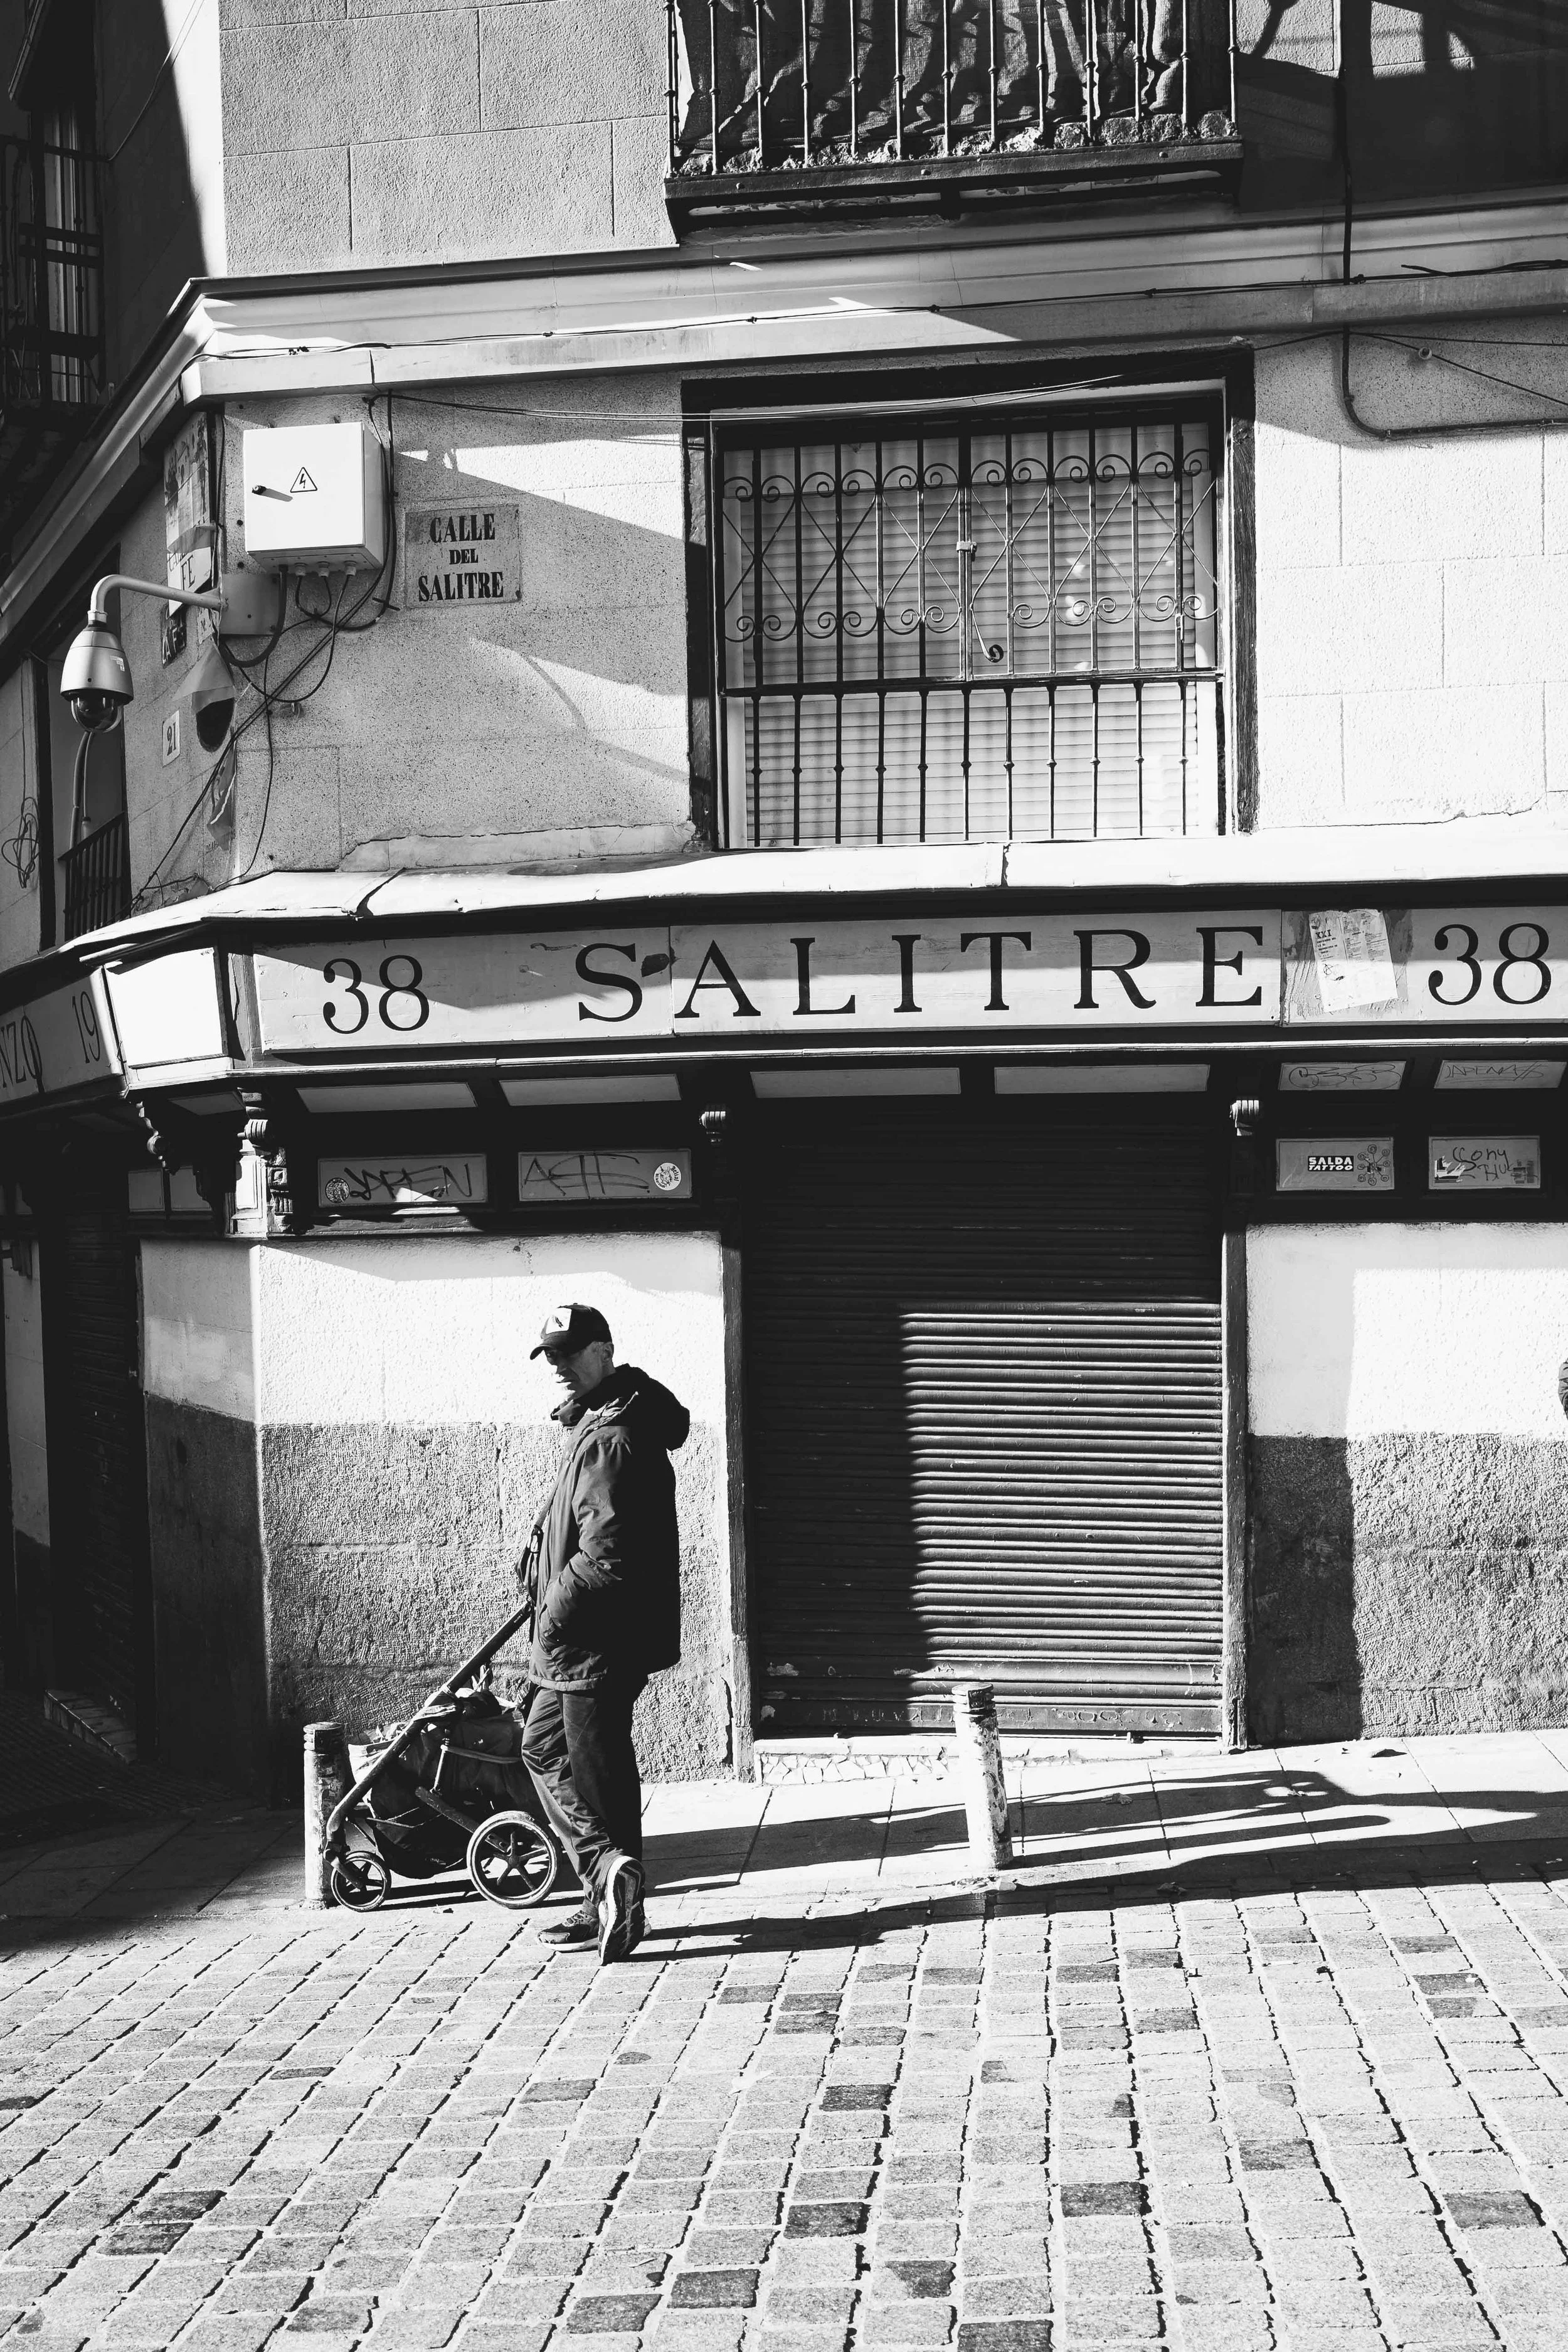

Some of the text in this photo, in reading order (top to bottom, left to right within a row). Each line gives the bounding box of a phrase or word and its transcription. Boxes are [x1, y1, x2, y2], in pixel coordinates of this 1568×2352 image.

[430, 513, 495, 543] CALLE
[449, 548, 479, 565] DEL
[181, 555, 196, 591] FE
[418, 572, 503, 602] SALITRE
[167, 722, 176, 756] 21
[322, 954, 430, 1035] 38
[575, 925, 1264, 1023] SALITRE
[1428, 922, 1551, 1006] 38
[72, 991, 100, 1064] 19
[1309, 1156, 1353, 1165] SALDA
